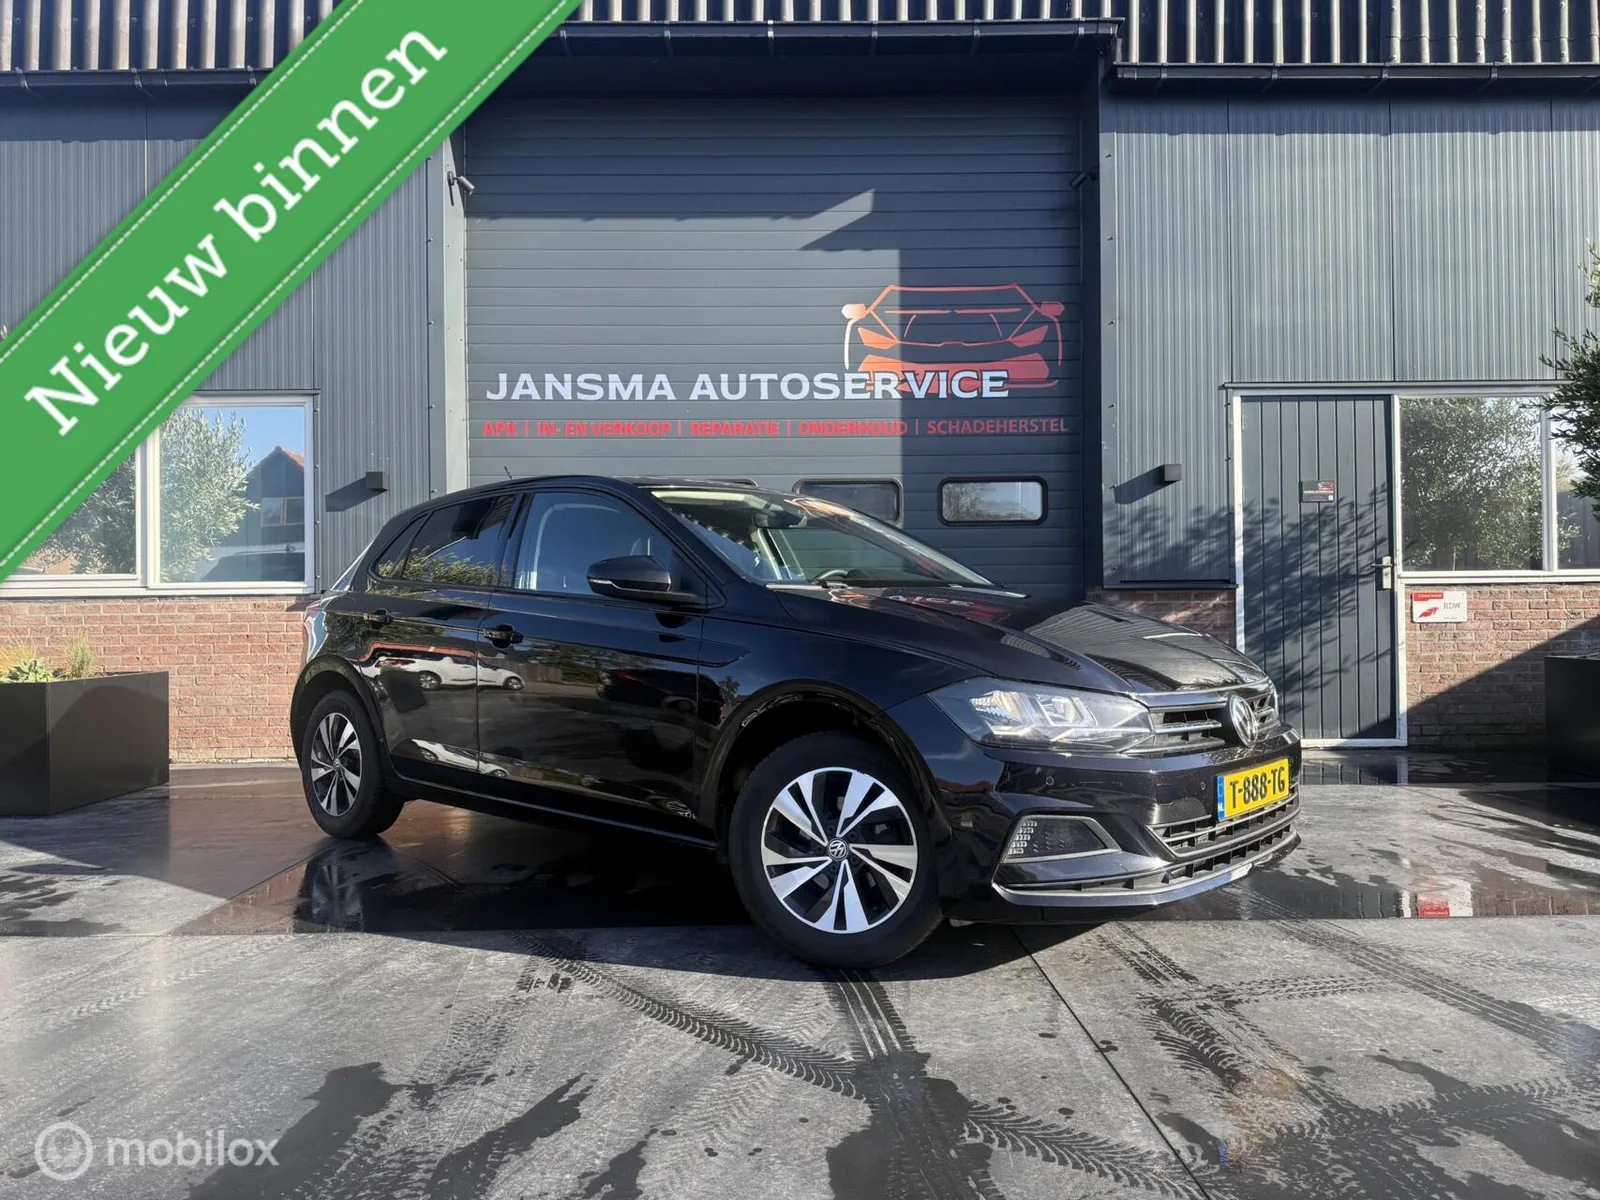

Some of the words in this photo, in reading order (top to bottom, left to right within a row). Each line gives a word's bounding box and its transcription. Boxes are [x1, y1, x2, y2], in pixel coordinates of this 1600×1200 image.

[486, 372, 677, 401] JANSMA
[689, 370, 1009, 400] AUTOSERVICE
[483, 420, 518, 437] APK
[564, 420, 588, 437] EN
[590, 420, 673, 437] VERKOOP
[691, 420, 780, 437] REPARATIE
[797, 419, 908, 436] ONDERHOUD
[927, 417, 1069, 435] SCHADEHERSTEL
[1443, 602, 1462, 610] RDW
[1229, 765, 1286, 809] T-888-TG
